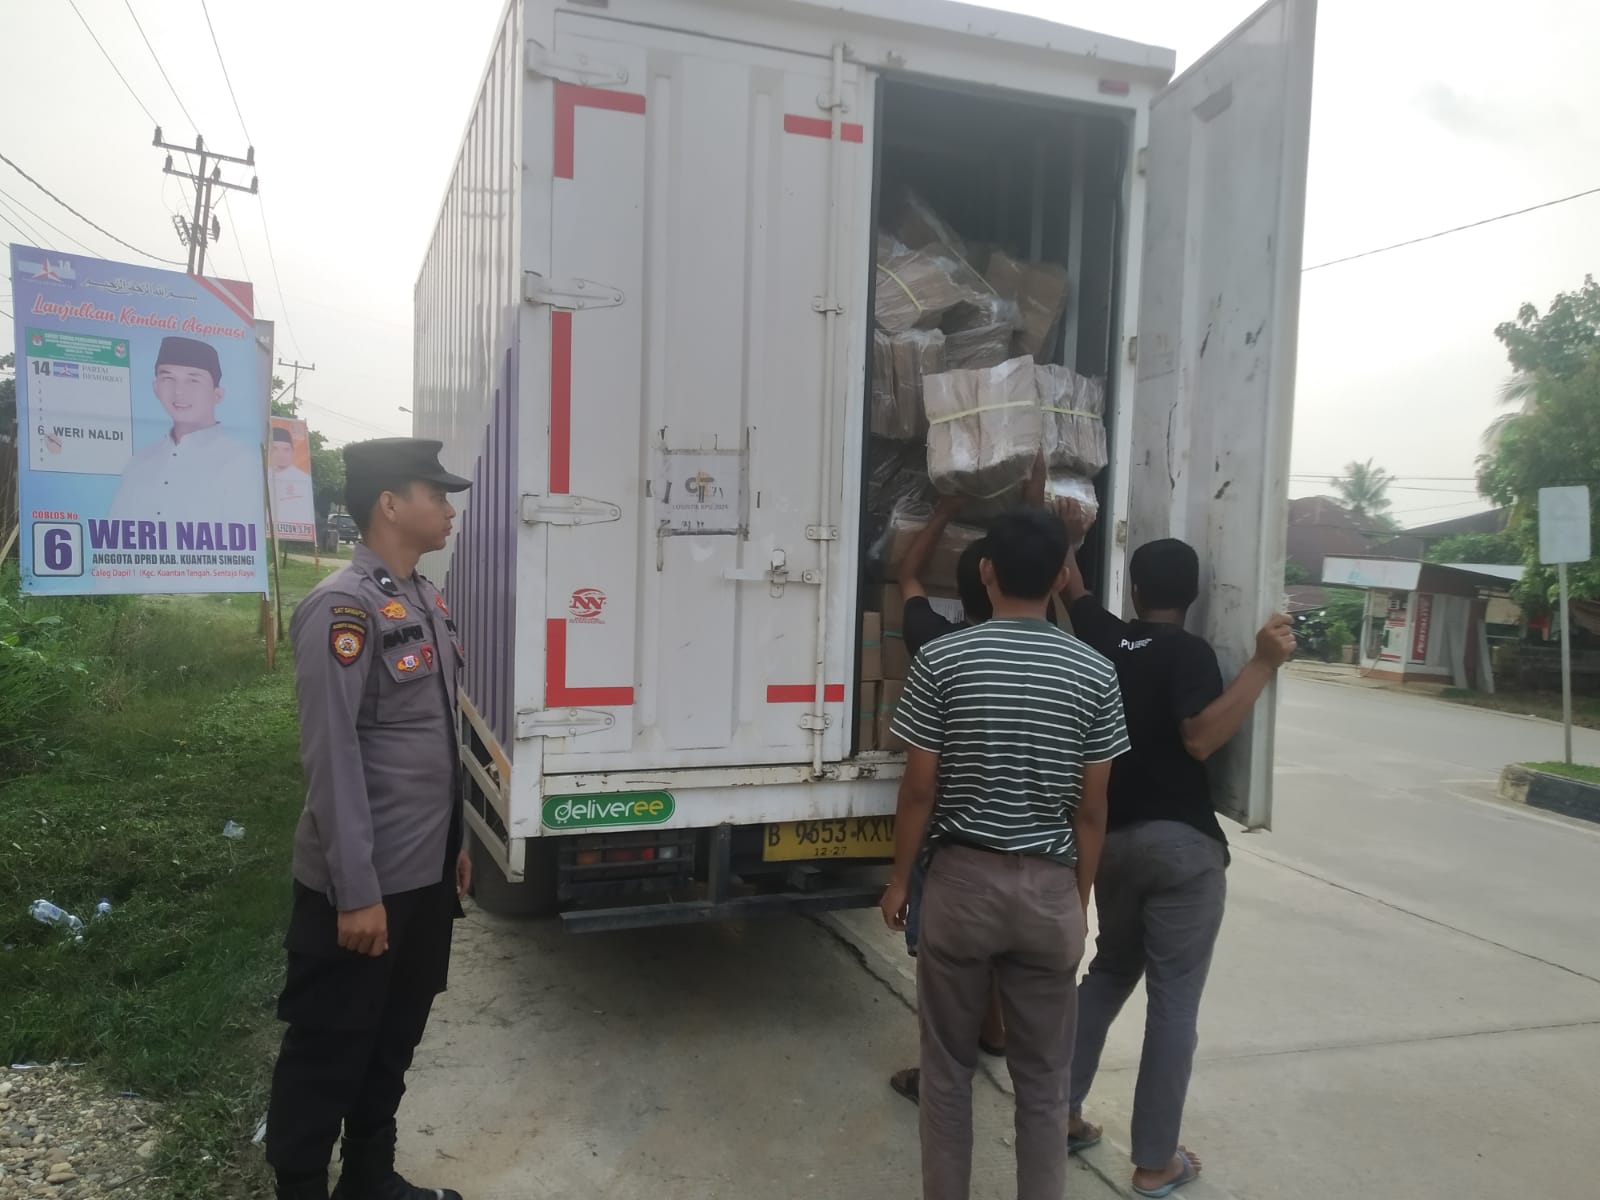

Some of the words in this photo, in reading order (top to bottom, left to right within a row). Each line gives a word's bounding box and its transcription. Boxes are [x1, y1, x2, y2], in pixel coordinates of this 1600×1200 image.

[120, 307, 177, 330] Kembali
[182, 316, 246, 337] Aspirasi
[32, 360, 51, 376] 14
[37, 425, 45, 435] 6
[53, 426, 84, 439] WERI
[88, 429, 124, 441] NALDI
[32, 510, 65, 520] COBLOS
[43, 528, 73, 571] 6
[87, 519, 168, 550] WERI
[175, 521, 257, 552] NALDI
[92, 553, 133, 565] ANGGOTA
[134, 553, 158, 565] DPRD
[159, 554, 179, 565] KAB.
[180, 554, 219, 566] KUANTAN
[219, 555, 255, 566] SINGINGI
[112, 568, 131, 579] Dapil
[157, 569, 186, 577] Kuantan
[555, 799, 664, 823] deliveree
[768, 823, 780, 847] B
